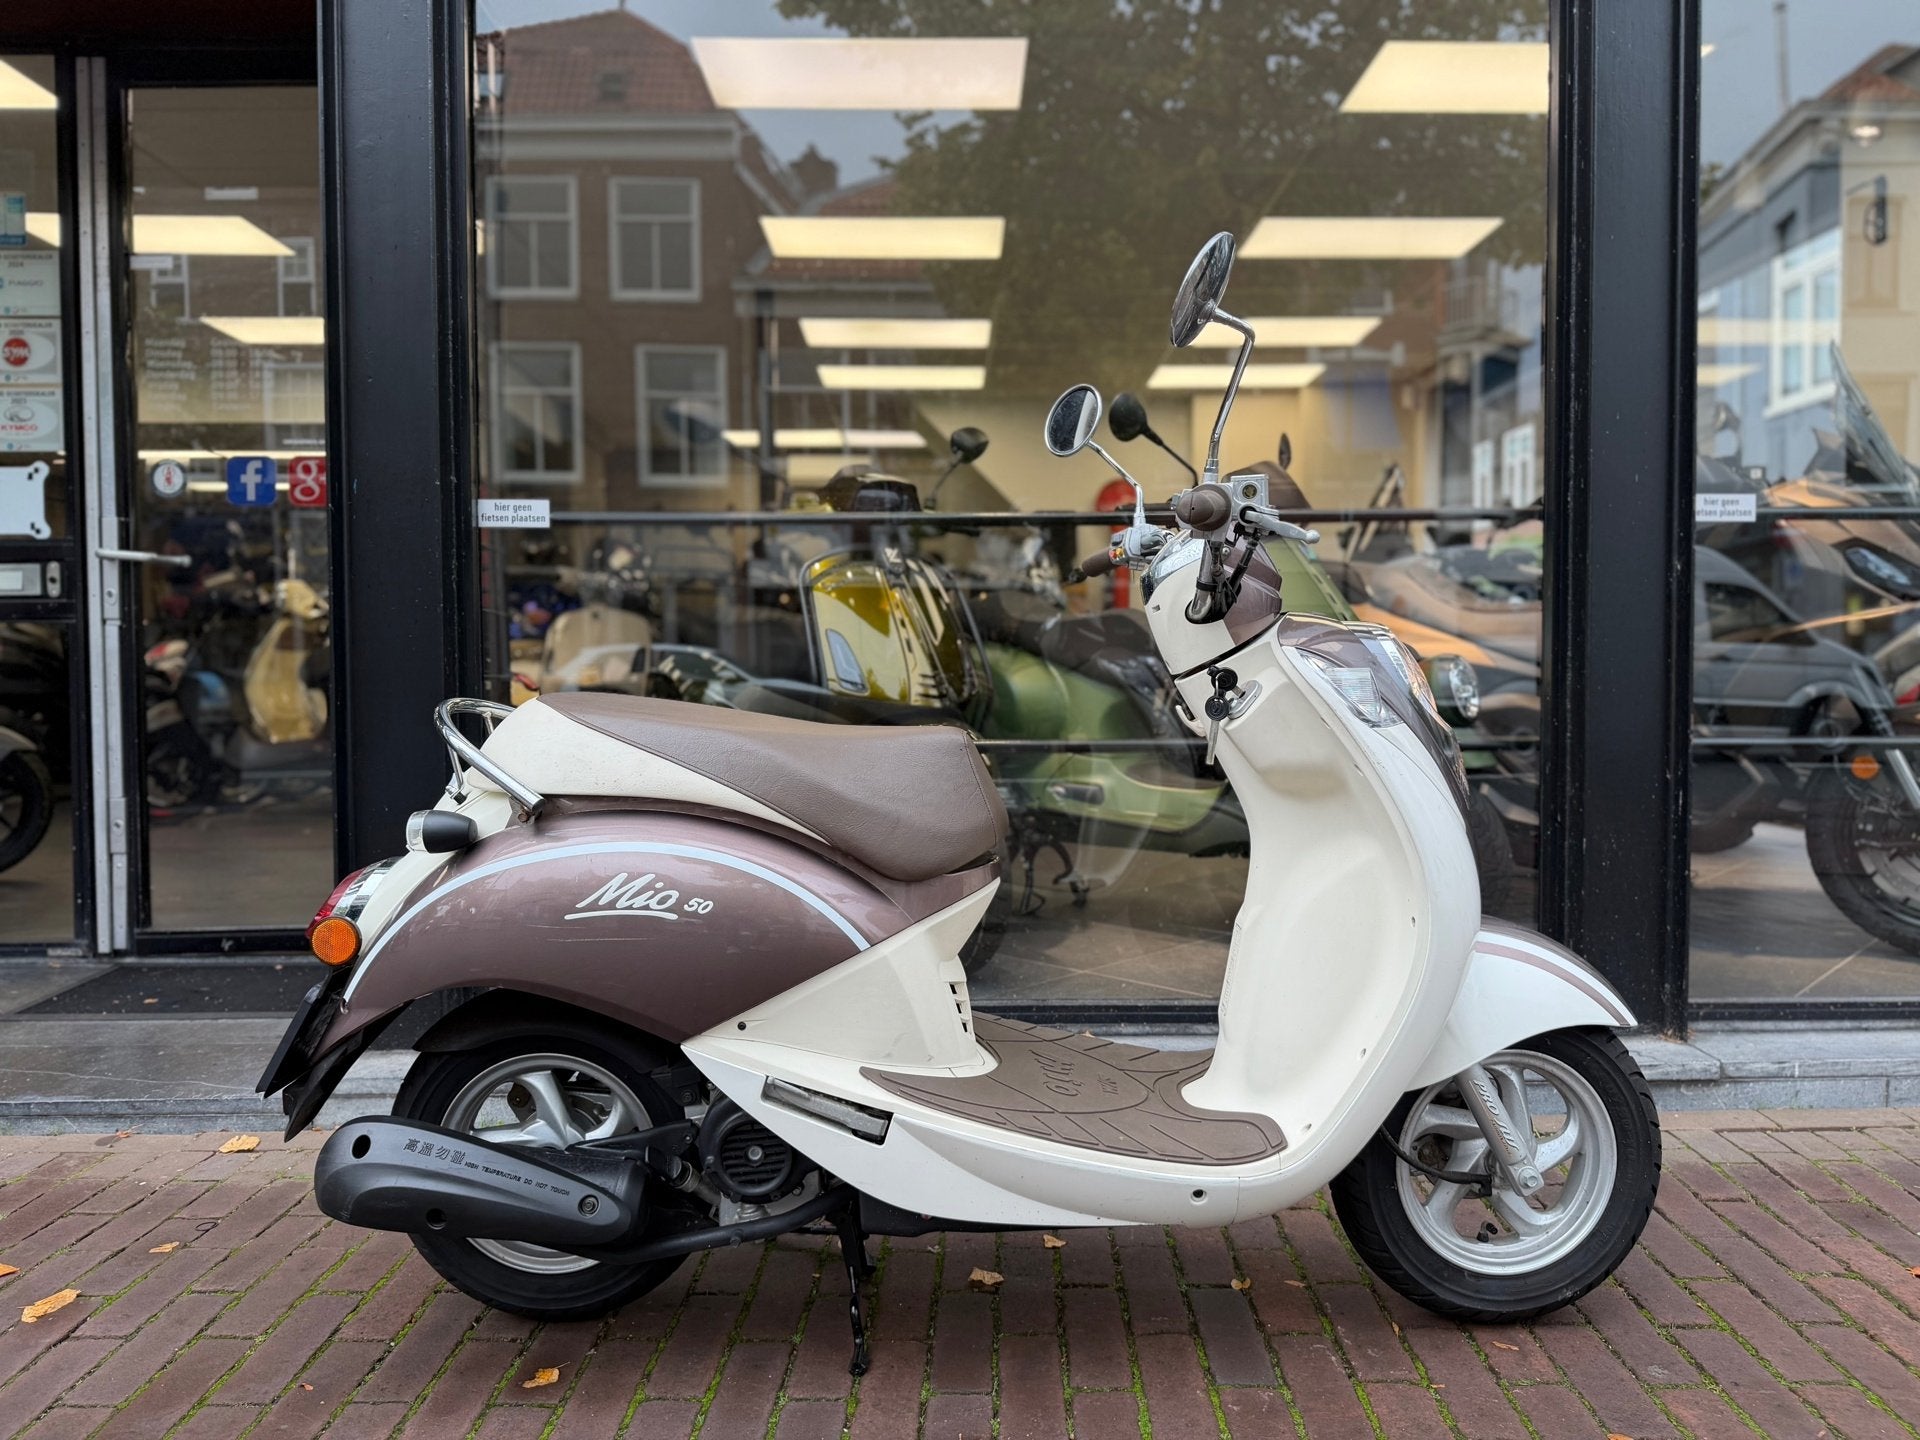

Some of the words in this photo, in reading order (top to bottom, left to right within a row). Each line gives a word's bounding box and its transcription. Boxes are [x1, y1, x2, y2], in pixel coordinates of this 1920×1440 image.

[494, 502, 511, 511] hier
[512, 504, 532, 513] geen
[1703, 497, 1719, 506] hier
[1721, 499, 1740, 508] geen
[481, 513, 509, 522] fietsen
[511, 513, 546, 524] plaatsen
[1696, 509, 1717, 517] etsen
[1719, 508, 1752, 518] plaatsen
[576, 872, 680, 910] Mio
[683, 897, 714, 915] 50
[481, 1165, 522, 1182] TEMPERATURE
[523, 1178, 534, 1186] DO
[535, 1181, 548, 1190] NOT
[550, 1185, 571, 1197] TOUCH
